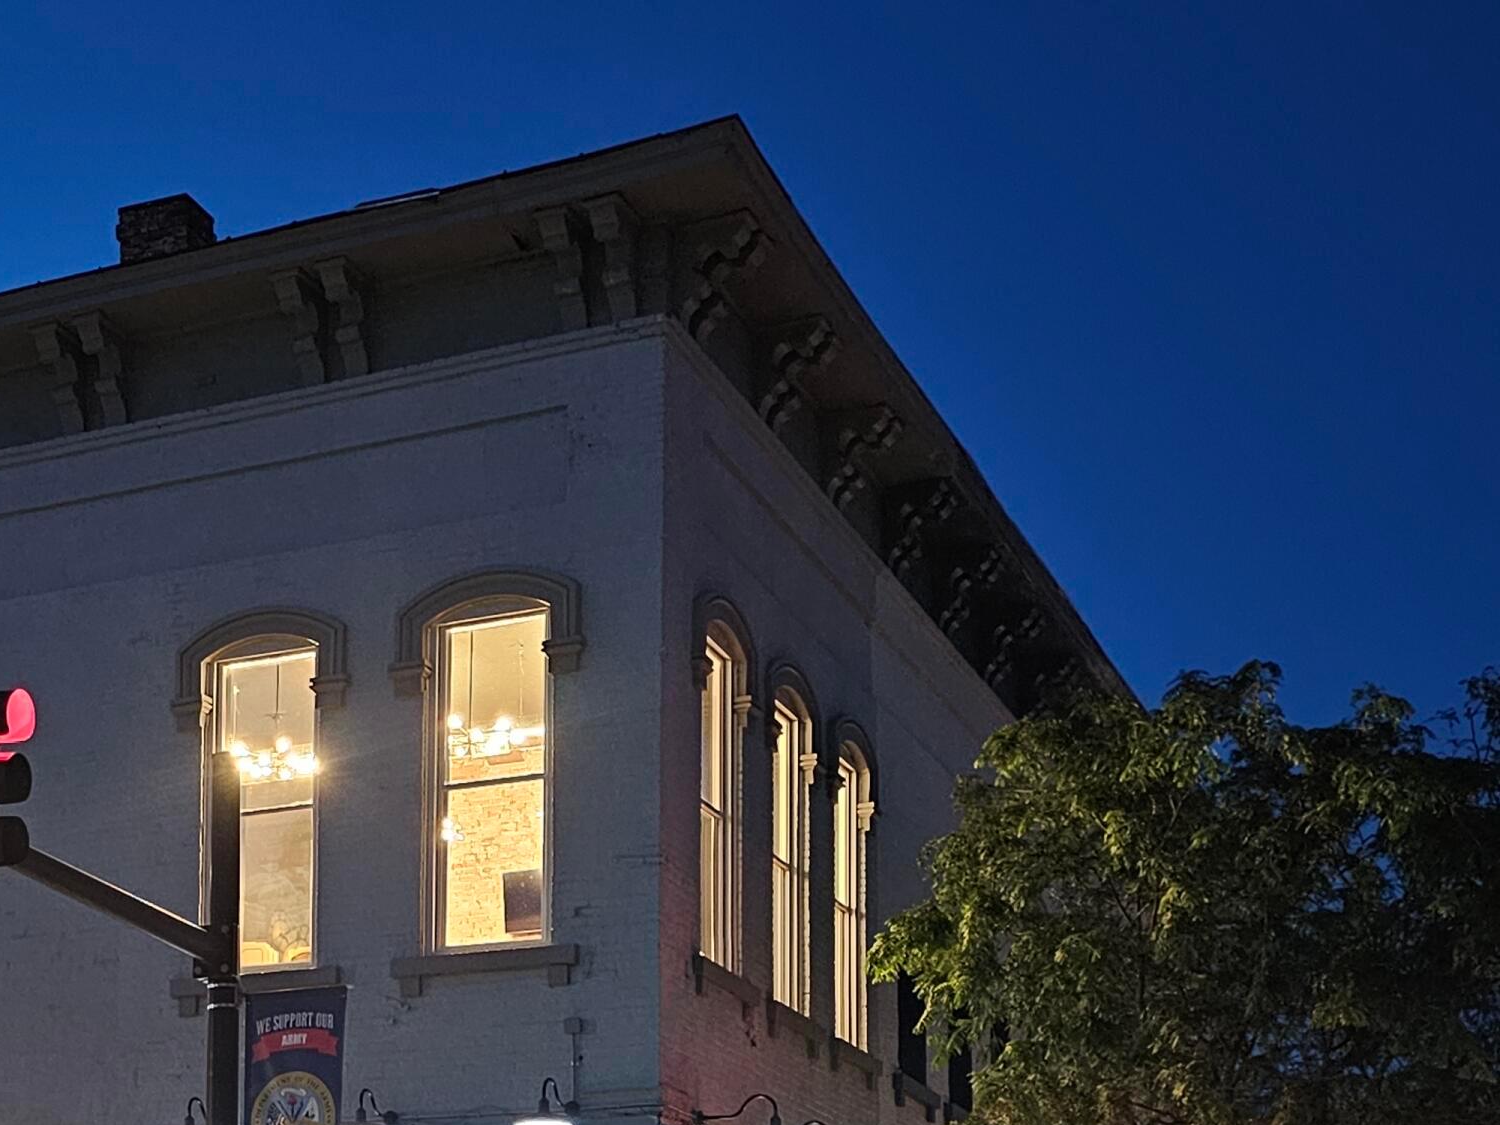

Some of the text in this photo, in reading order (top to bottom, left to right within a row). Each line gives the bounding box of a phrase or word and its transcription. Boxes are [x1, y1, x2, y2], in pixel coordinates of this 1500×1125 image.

[256, 1011, 335, 1036] WE SUPPORT OUR
